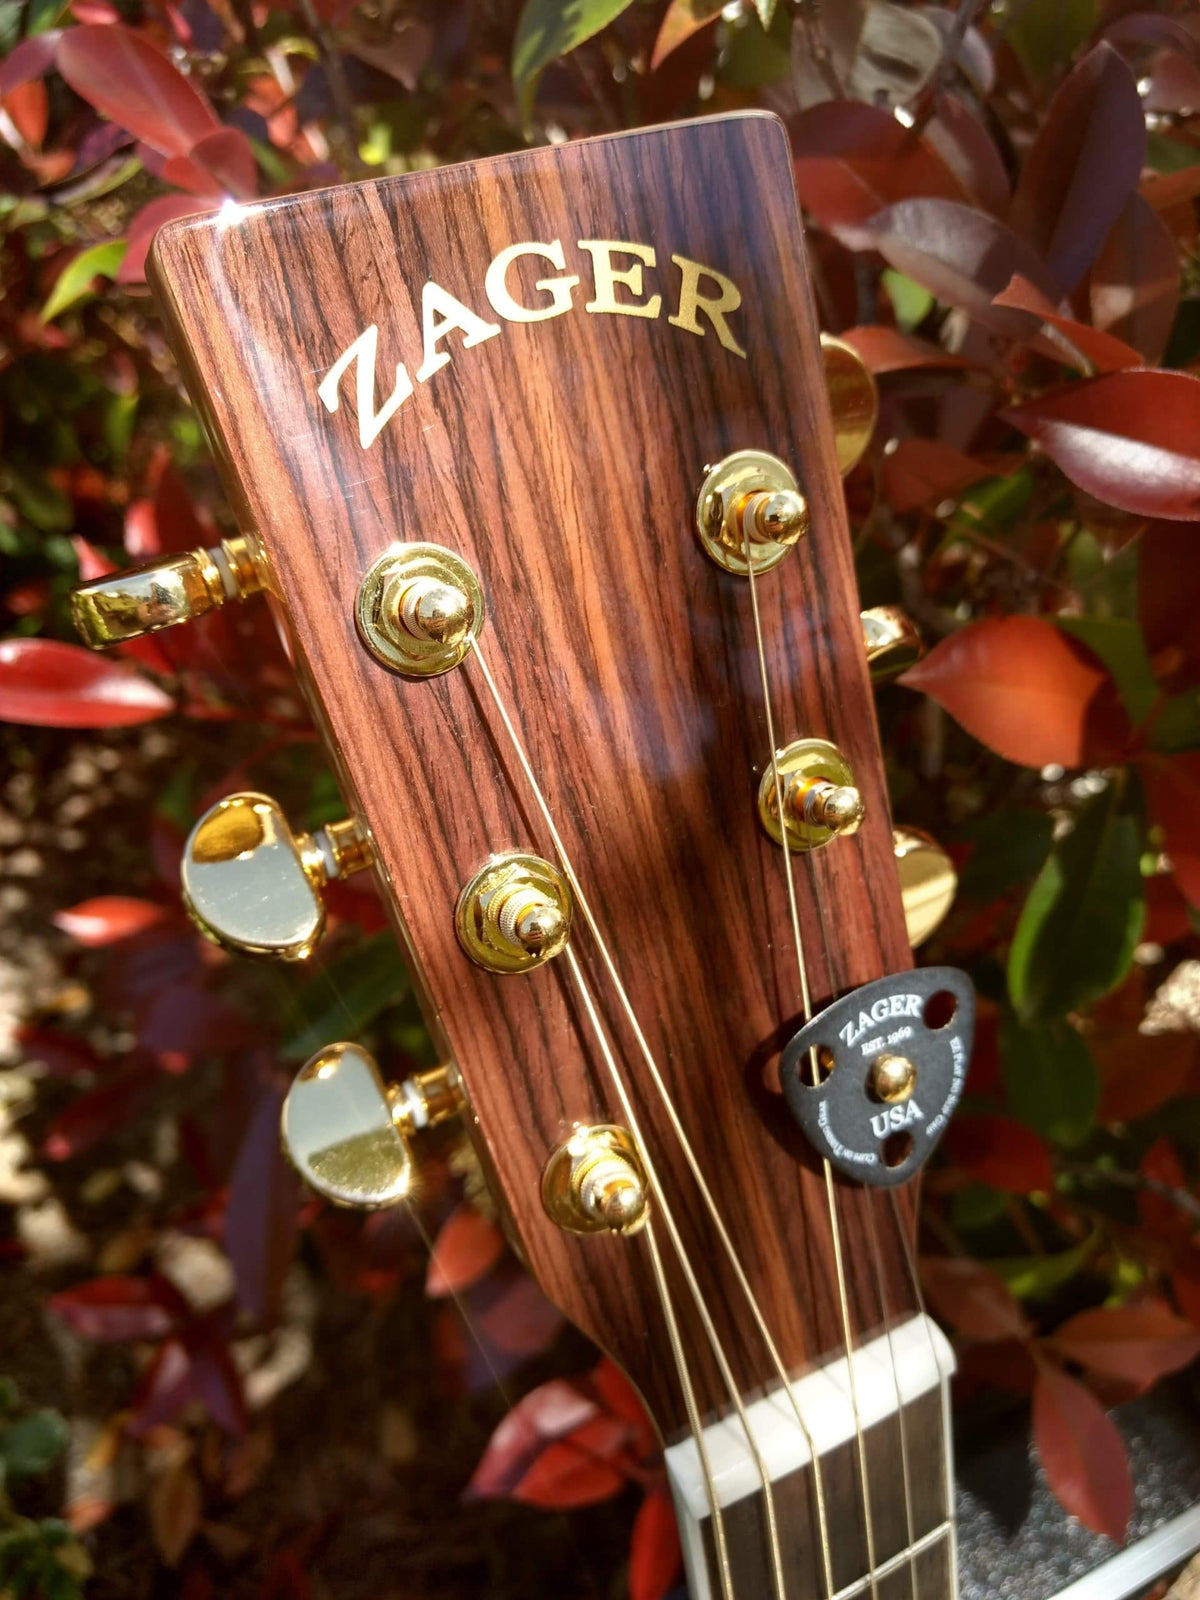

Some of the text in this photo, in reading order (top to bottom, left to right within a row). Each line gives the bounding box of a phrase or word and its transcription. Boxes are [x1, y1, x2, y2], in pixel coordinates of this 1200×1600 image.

[318, 239, 746, 449] ZAGER
[839, 994, 925, 1047] ZAGER
[860, 1036, 885, 1056] EST.
[869, 1099, 925, 1138] USA
